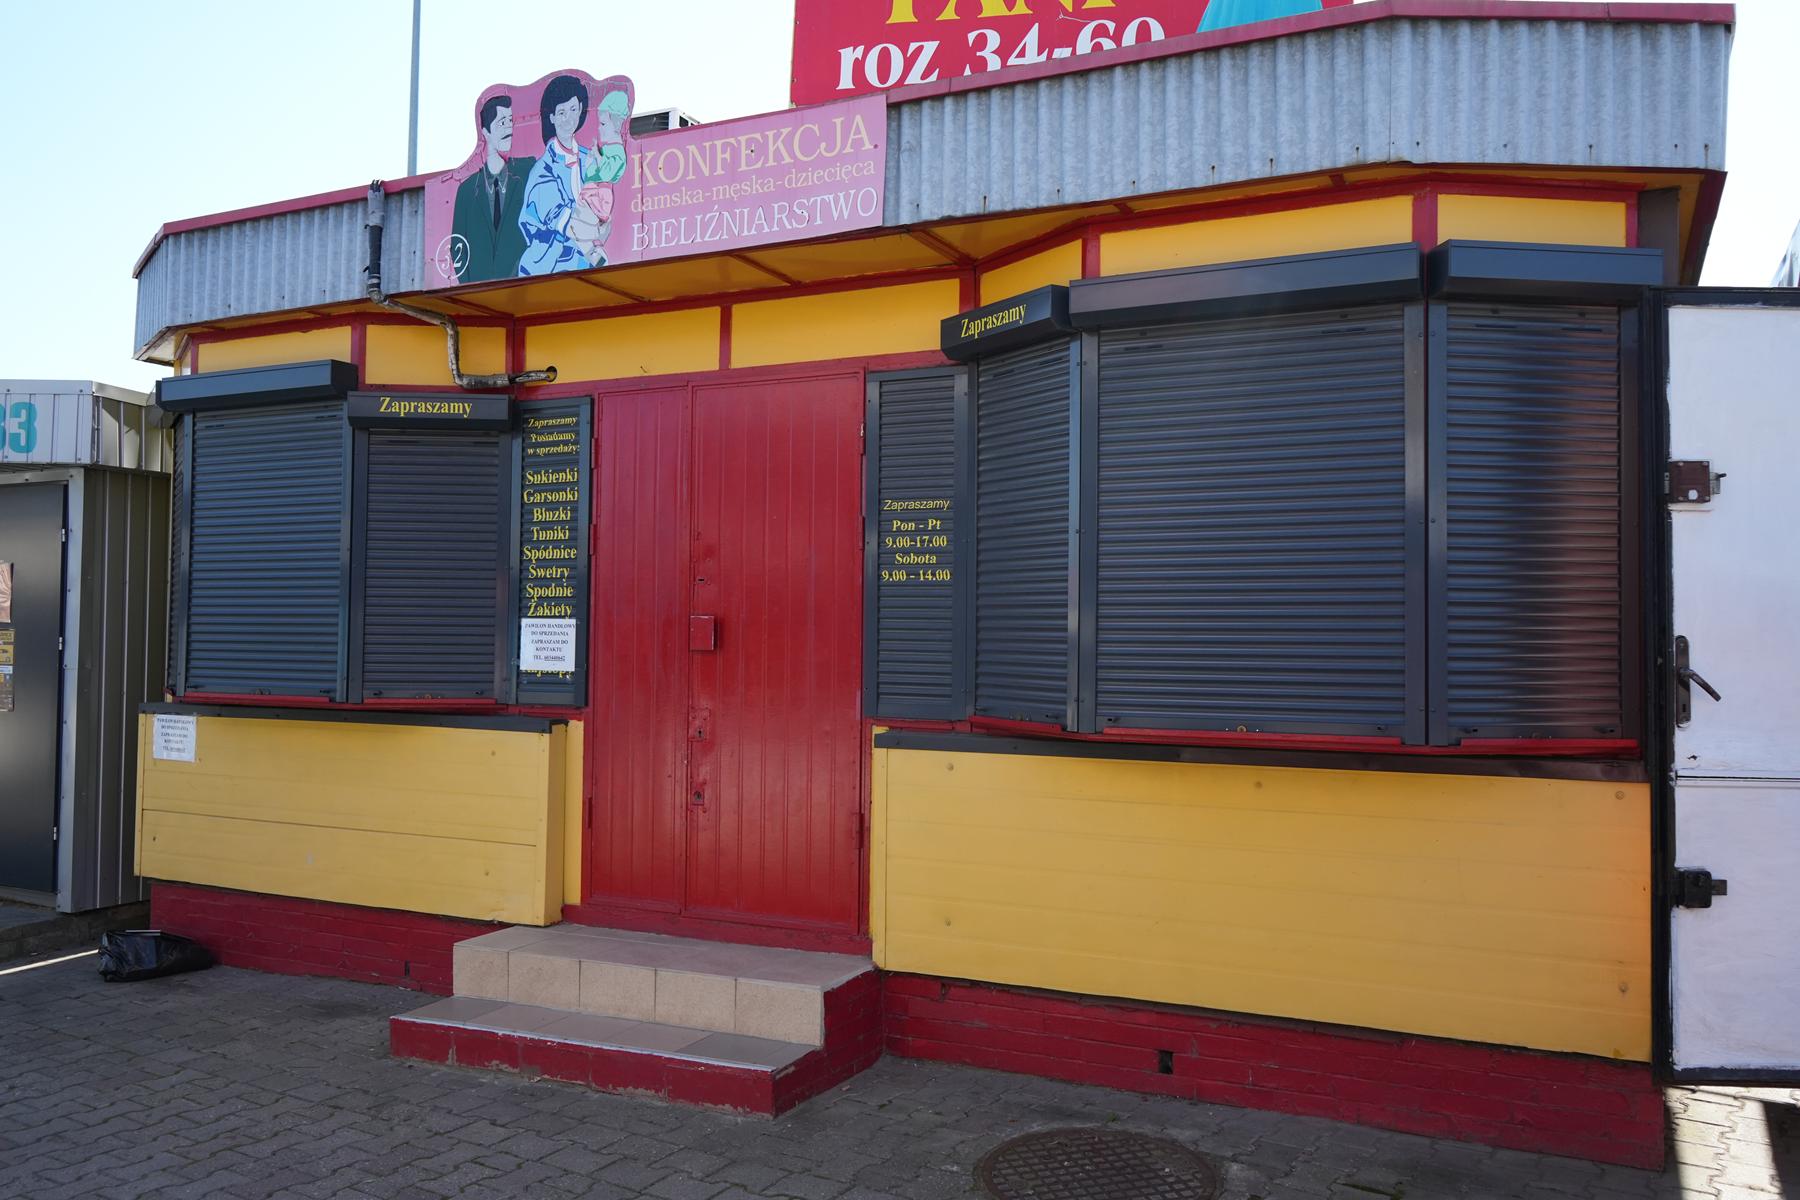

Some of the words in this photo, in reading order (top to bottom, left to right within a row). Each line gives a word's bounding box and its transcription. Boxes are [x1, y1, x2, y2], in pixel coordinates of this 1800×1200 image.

[835, 40, 941, 91] roz
[631, 113, 874, 189] KONFEKCJA
[630, 160, 876, 214] damska-męska-dziecięca
[631, 187, 878, 252] BIELIŹNIARSTWO
[960, 303, 1027, 339] Zapraszamy
[379, 396, 473, 419] Zapraszamy
[0, 402, 37, 453] 3
[527, 416, 578, 429] Zapraszamy
[530, 432, 576, 442] Posiadamy
[536, 443, 580, 457] sprzedaży:
[525, 467, 578, 485] Sukienki
[523, 486, 578, 504] Garsonki
[532, 506, 571, 522] Bluzki
[883, 499, 950, 512] Zapraszamy
[530, 525, 569, 541] Tuniki
[892, 519, 915, 532] Pon
[927, 518, 942, 530] Pt
[885, 535, 947, 548] 9.00-17.00
[523, 545, 577, 563] Spódnice
[895, 552, 937, 565] Sobota
[528, 564, 570, 582] Swetry
[881, 569, 907, 582] 9.00
[919, 568, 951, 581] 14.00
[526, 583, 574, 602] Spodnie
